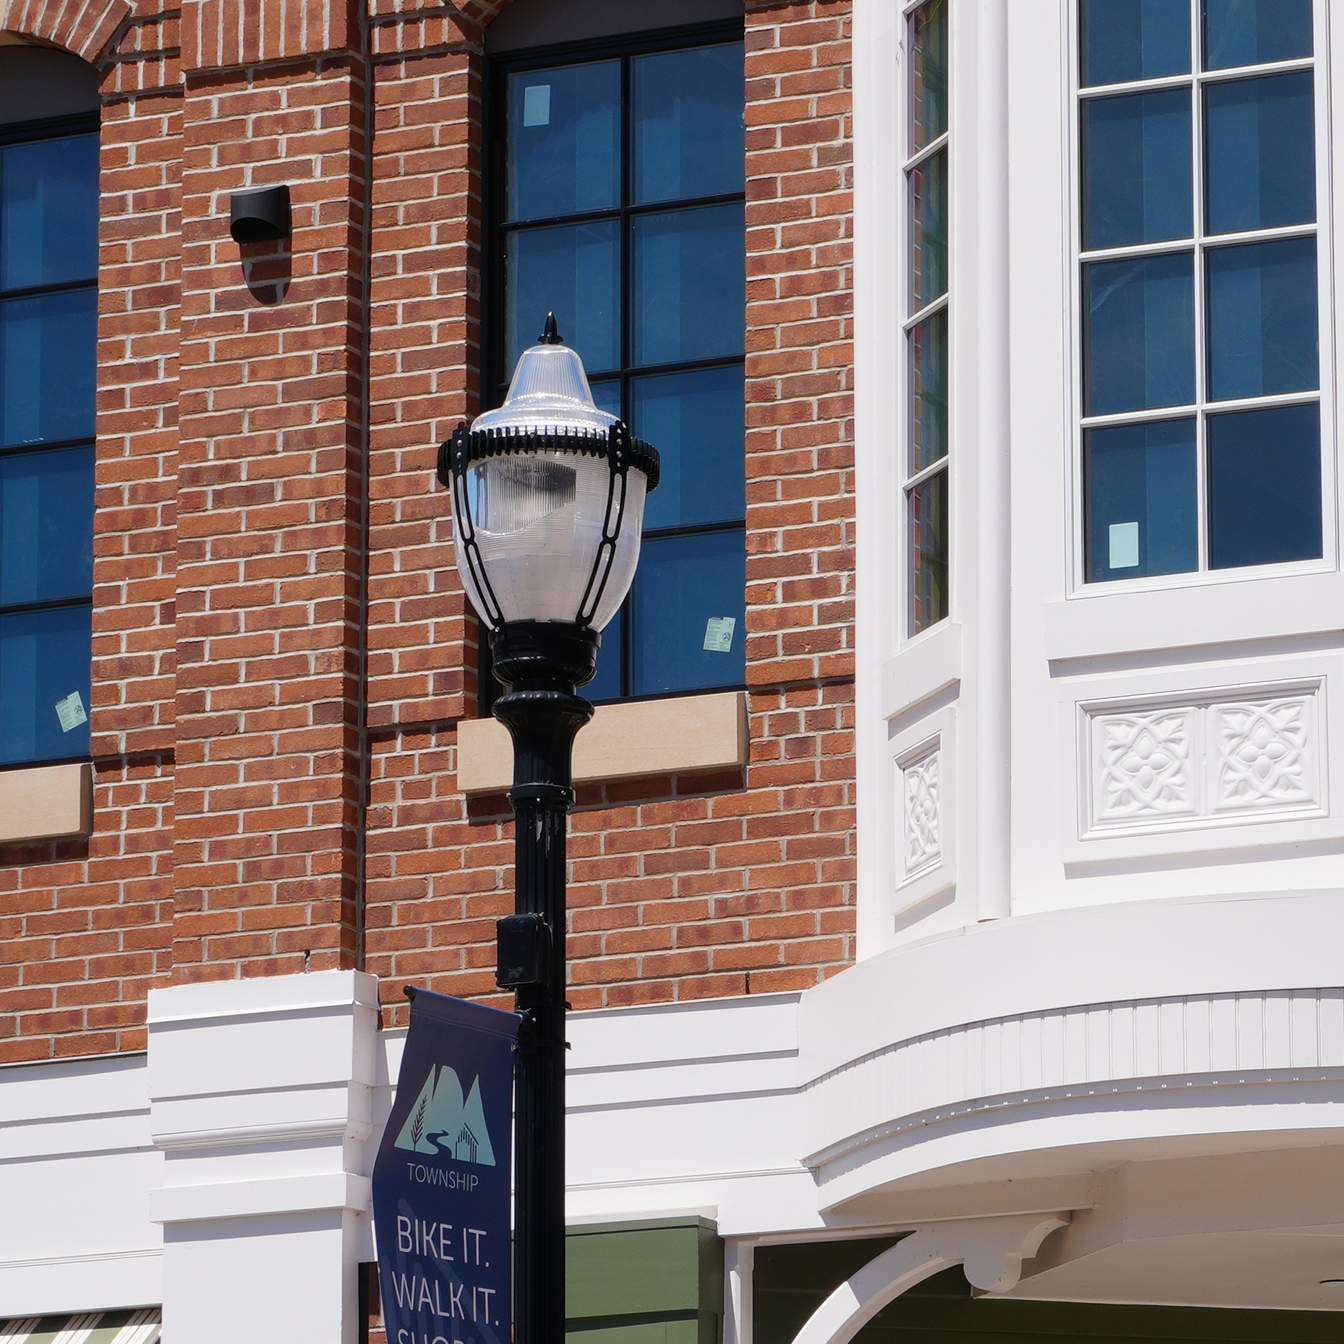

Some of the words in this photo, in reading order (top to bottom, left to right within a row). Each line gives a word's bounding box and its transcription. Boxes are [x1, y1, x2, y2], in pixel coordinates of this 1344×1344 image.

[406, 1162, 479, 1192] TOWNSHIP
[397, 1215, 454, 1261] BIKE
[463, 1227, 490, 1267] IT.
[391, 1271, 465, 1320] WALK
[473, 1286, 499, 1326] IT.
